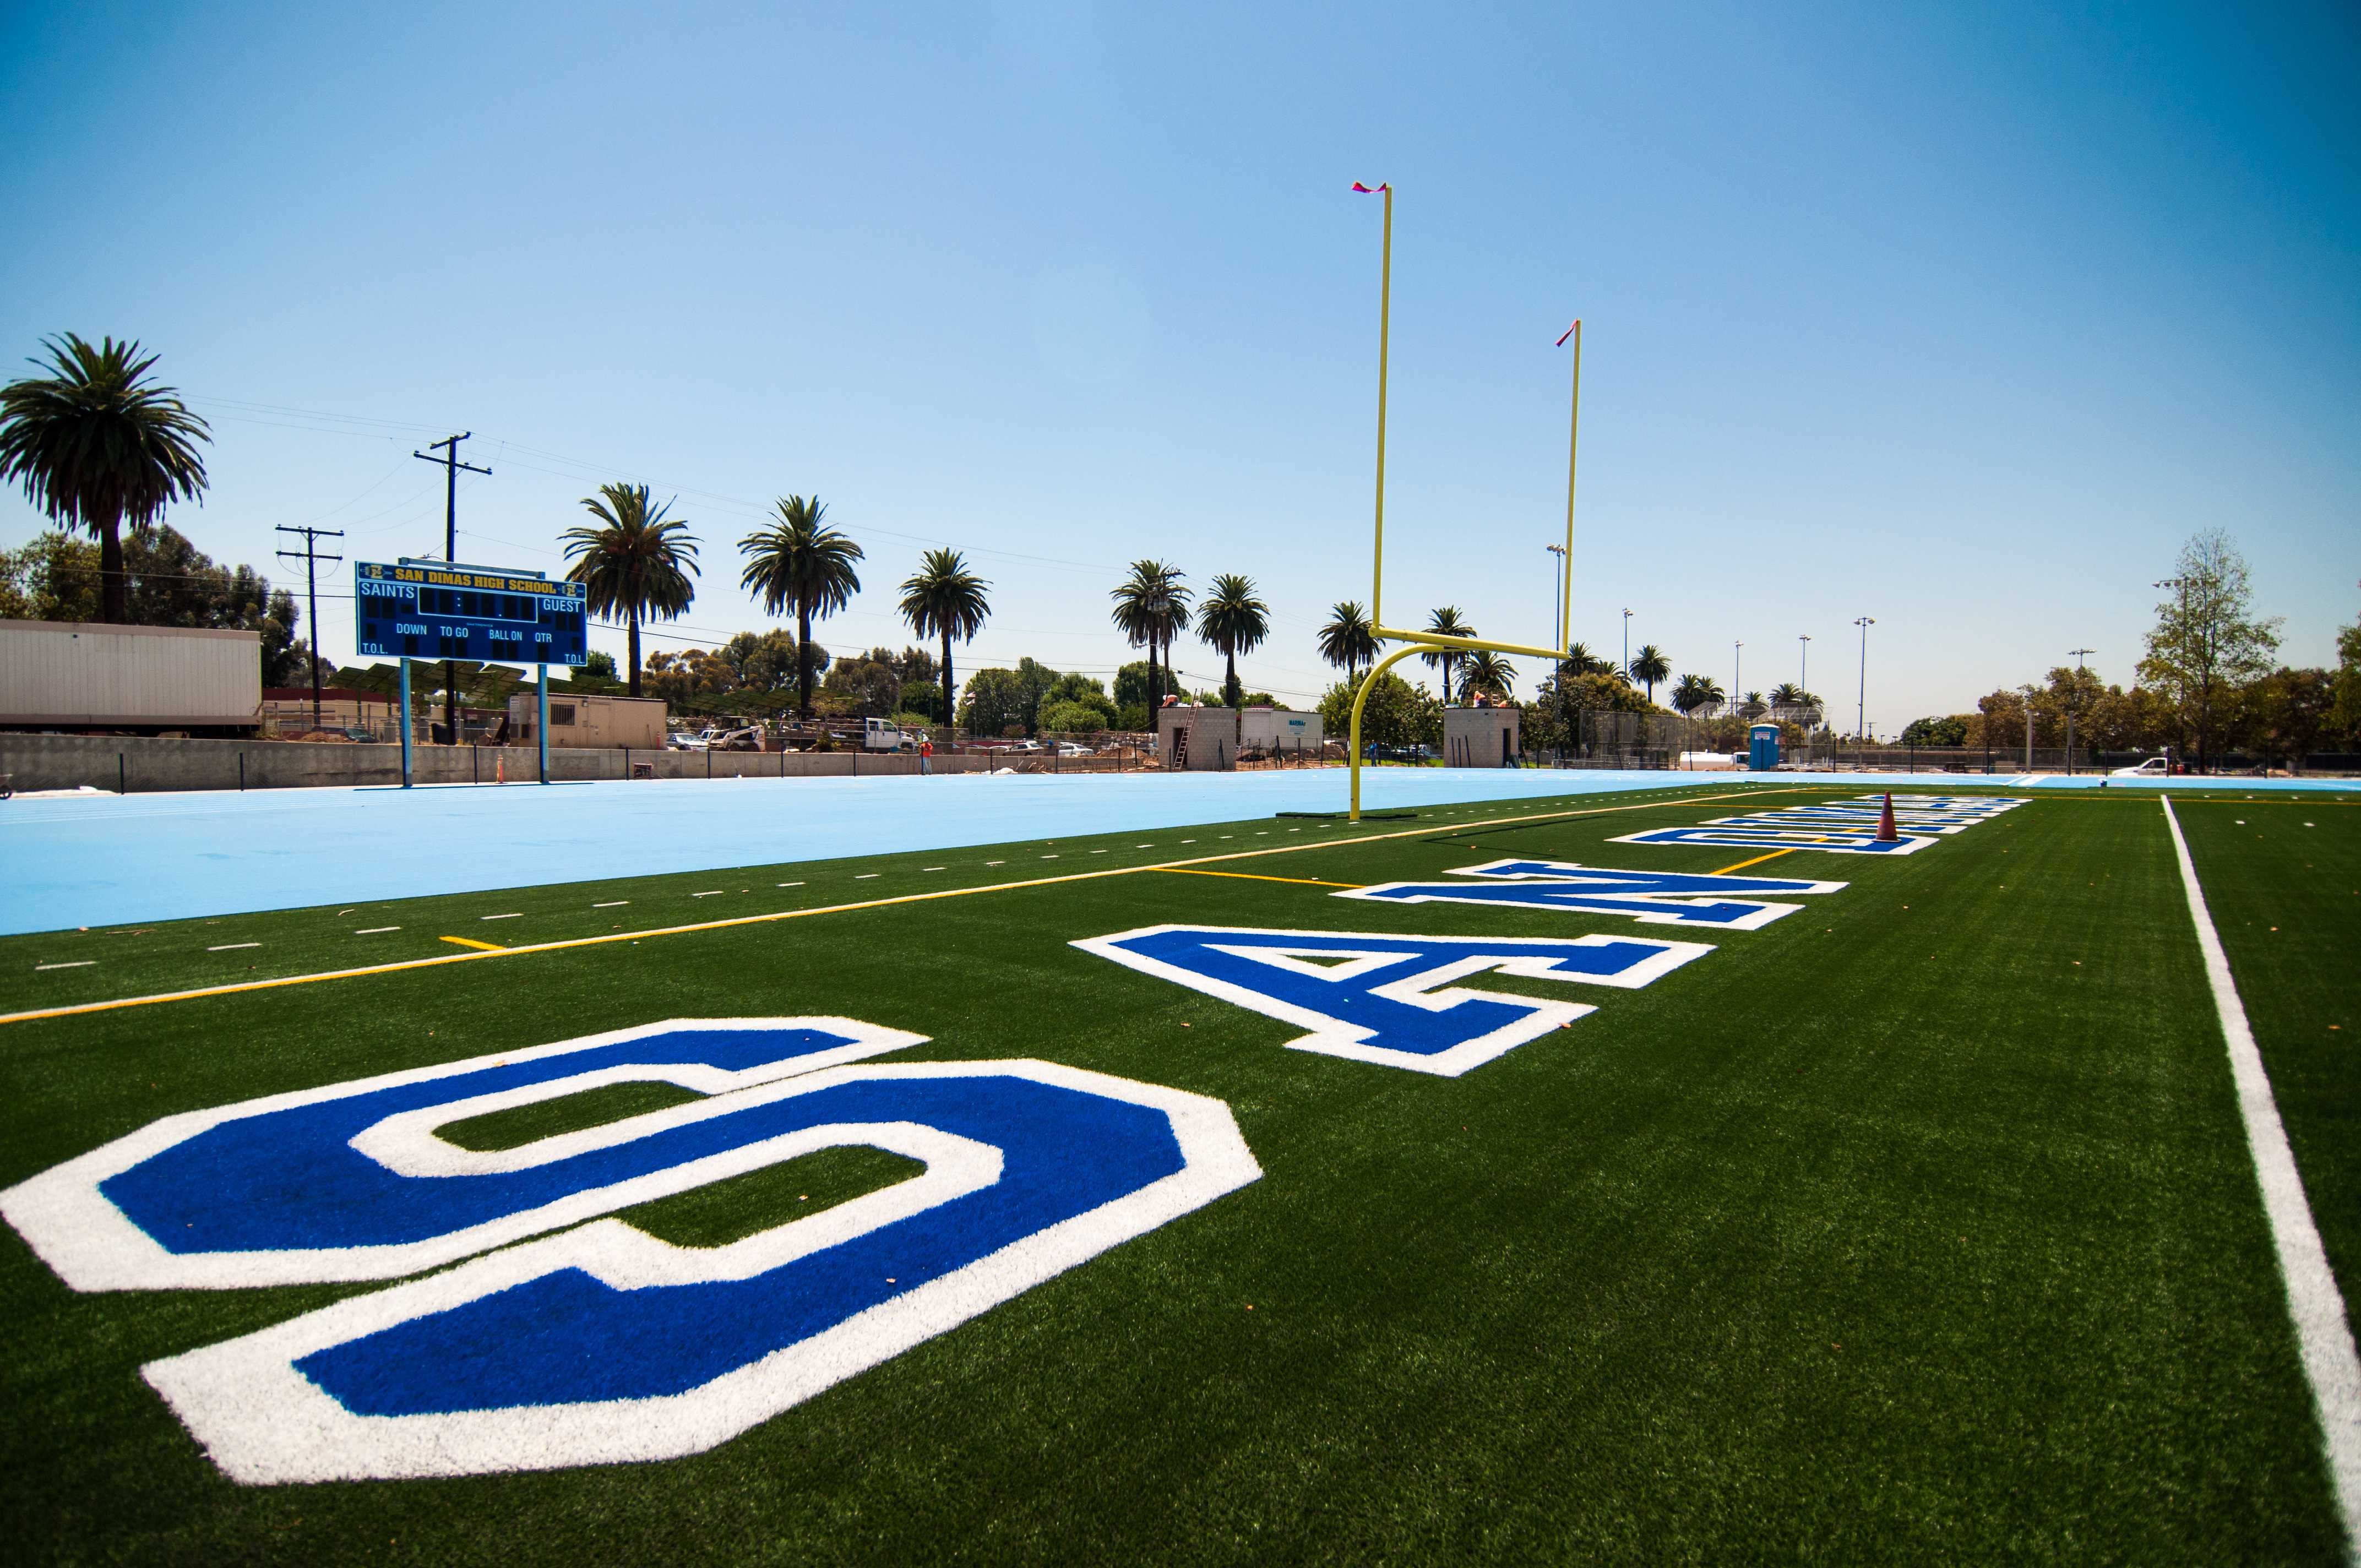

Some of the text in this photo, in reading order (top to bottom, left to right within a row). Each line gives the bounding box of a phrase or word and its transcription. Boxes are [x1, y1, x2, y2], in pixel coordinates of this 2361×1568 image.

[395, 568, 423, 581] SAN
[428, 571, 471, 586] DIMAS
[474, 576, 505, 589] HIGH
[509, 579, 556, 594] SCHOOL
[361, 582, 415, 598] SAINTS
[543, 598, 580, 612] GUEST
[396, 623, 427, 635] DOWN
[440, 626, 469, 638] TO GO
[489, 629, 523, 641] BALL ON
[535, 633, 552, 643] QTR
[362, 643, 388, 654] T.O.L.
[0, 858, 1850, 1485] SAN
